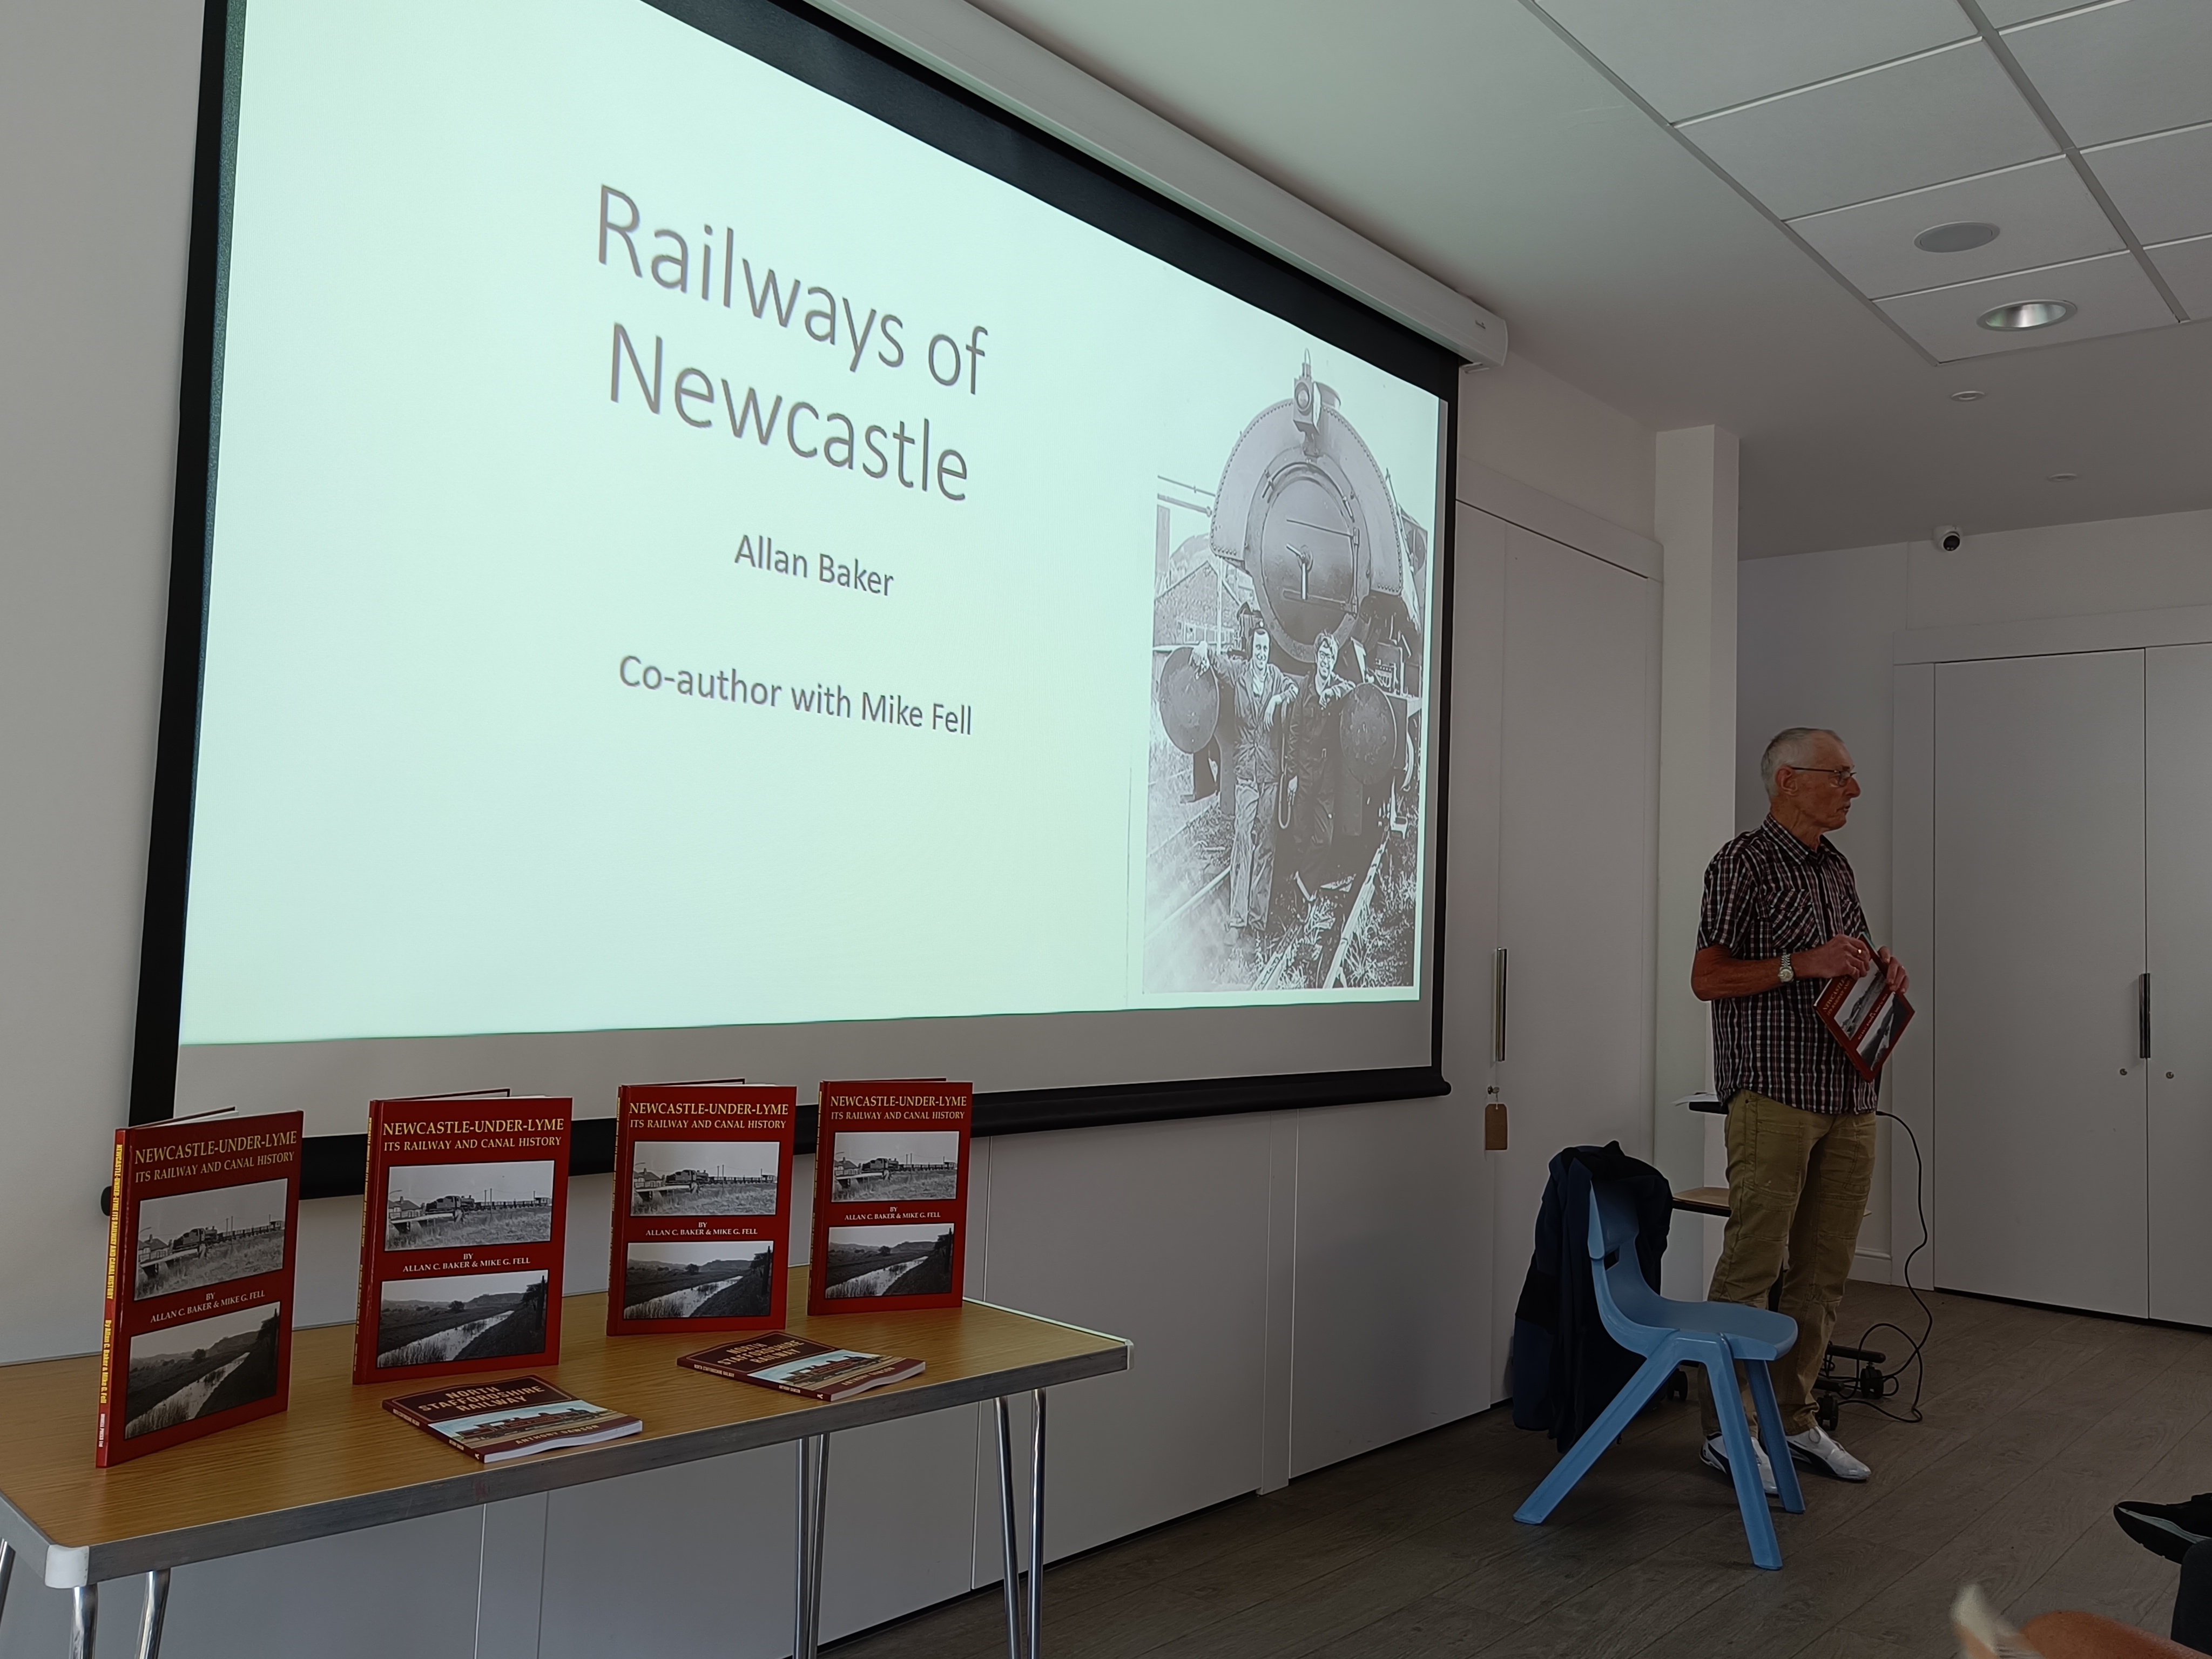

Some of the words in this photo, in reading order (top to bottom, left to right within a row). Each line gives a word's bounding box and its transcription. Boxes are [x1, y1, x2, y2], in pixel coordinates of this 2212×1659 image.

[598, 184, 903, 372] Railways
[928, 325, 988, 394] of
[611, 322, 967, 501] Newcastle
[734, 534, 807, 577] Allan
[819, 553, 894, 596] Baker
[619, 655, 781, 707] Co-author
[792, 685, 851, 718] with
[862, 692, 923, 727] Mike
[932, 703, 971, 735] Fell
[629, 1103, 788, 1115] NEWCASTLE-UNDER-LYME
[831, 1096, 967, 1106] NEWCASTLE-UNDER-LYME
[383, 1118, 564, 1135] NEWCASTLE-UNDER-LYME
[648, 1120, 689, 1128] RAILWAY
[691, 1120, 711, 1128] AND
[714, 1120, 745, 1128] CANAL
[135, 1131, 296, 1164] NEWCASTLE-UNDER-LYME
[384, 1142, 400, 1151] ITS
[404, 1141, 451, 1150] RAILWAY
[455, 1139, 477, 1149] AND
[481, 1138, 515, 1148] CANAL
[518, 1137, 561, 1147] HISTORY
[136, 1171, 150, 1183] ITS
[154, 1165, 198, 1180] RAILWAY
[200, 1161, 221, 1174] AND
[224, 1157, 254, 1170] CANAL
[257, 1151, 295, 1165] HISTORY
[206, 1292, 215, 1300] BY
[151, 1310, 177, 1323] ALLAN
[187, 1302, 212, 1314] BAKER
[221, 1296, 240, 1306] MIKE
[249, 1290, 265, 1300] FELL
[717, 1340, 805, 1365] STAFFORDSHIRE
[726, 1343, 767, 1354] NORTH
[749, 1348, 801, 1364] RAILWAY
[418, 1386, 545, 1411] STAFFORDSHIRE
[445, 1386, 501, 1399] NORTH
[456, 1396, 527, 1411] RAILWAY
[515, 1432, 558, 1445] ANTHONY
